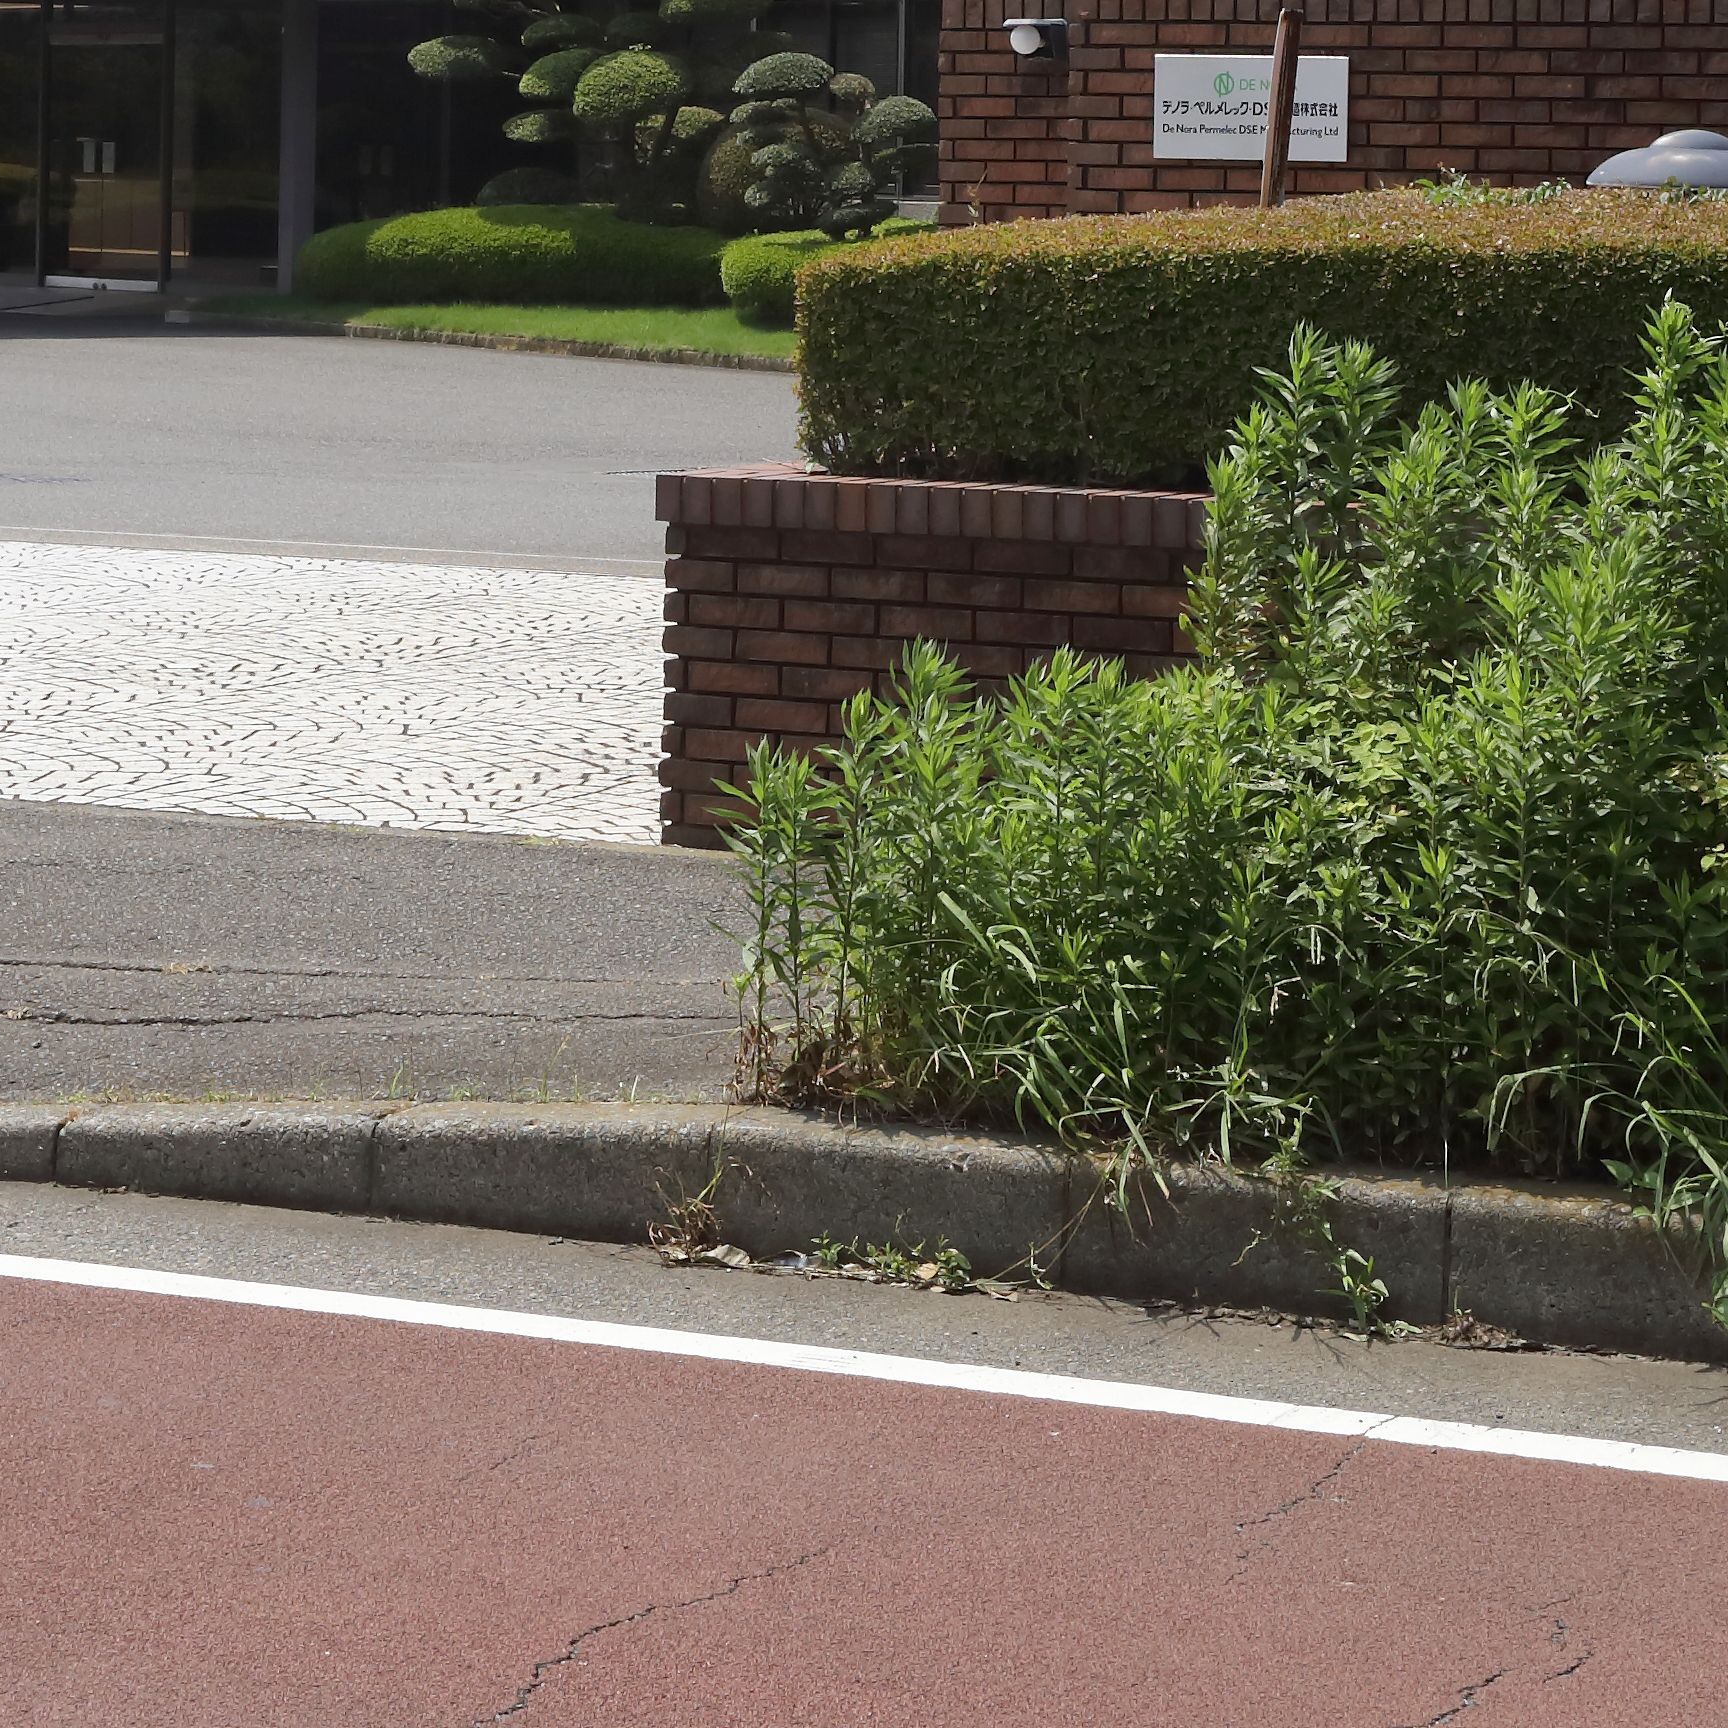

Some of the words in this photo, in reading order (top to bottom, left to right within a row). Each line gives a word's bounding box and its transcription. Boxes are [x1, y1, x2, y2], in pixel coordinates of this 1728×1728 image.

[1239, 78, 1256, 91] DE
[1162, 123, 1175, 134] De
[1176, 124, 1197, 134] Nora
[1199, 124, 1237, 134] Permelec
[1239, 124, 1258, 135] DSE
[1324, 126, 1339, 136] Ltd
